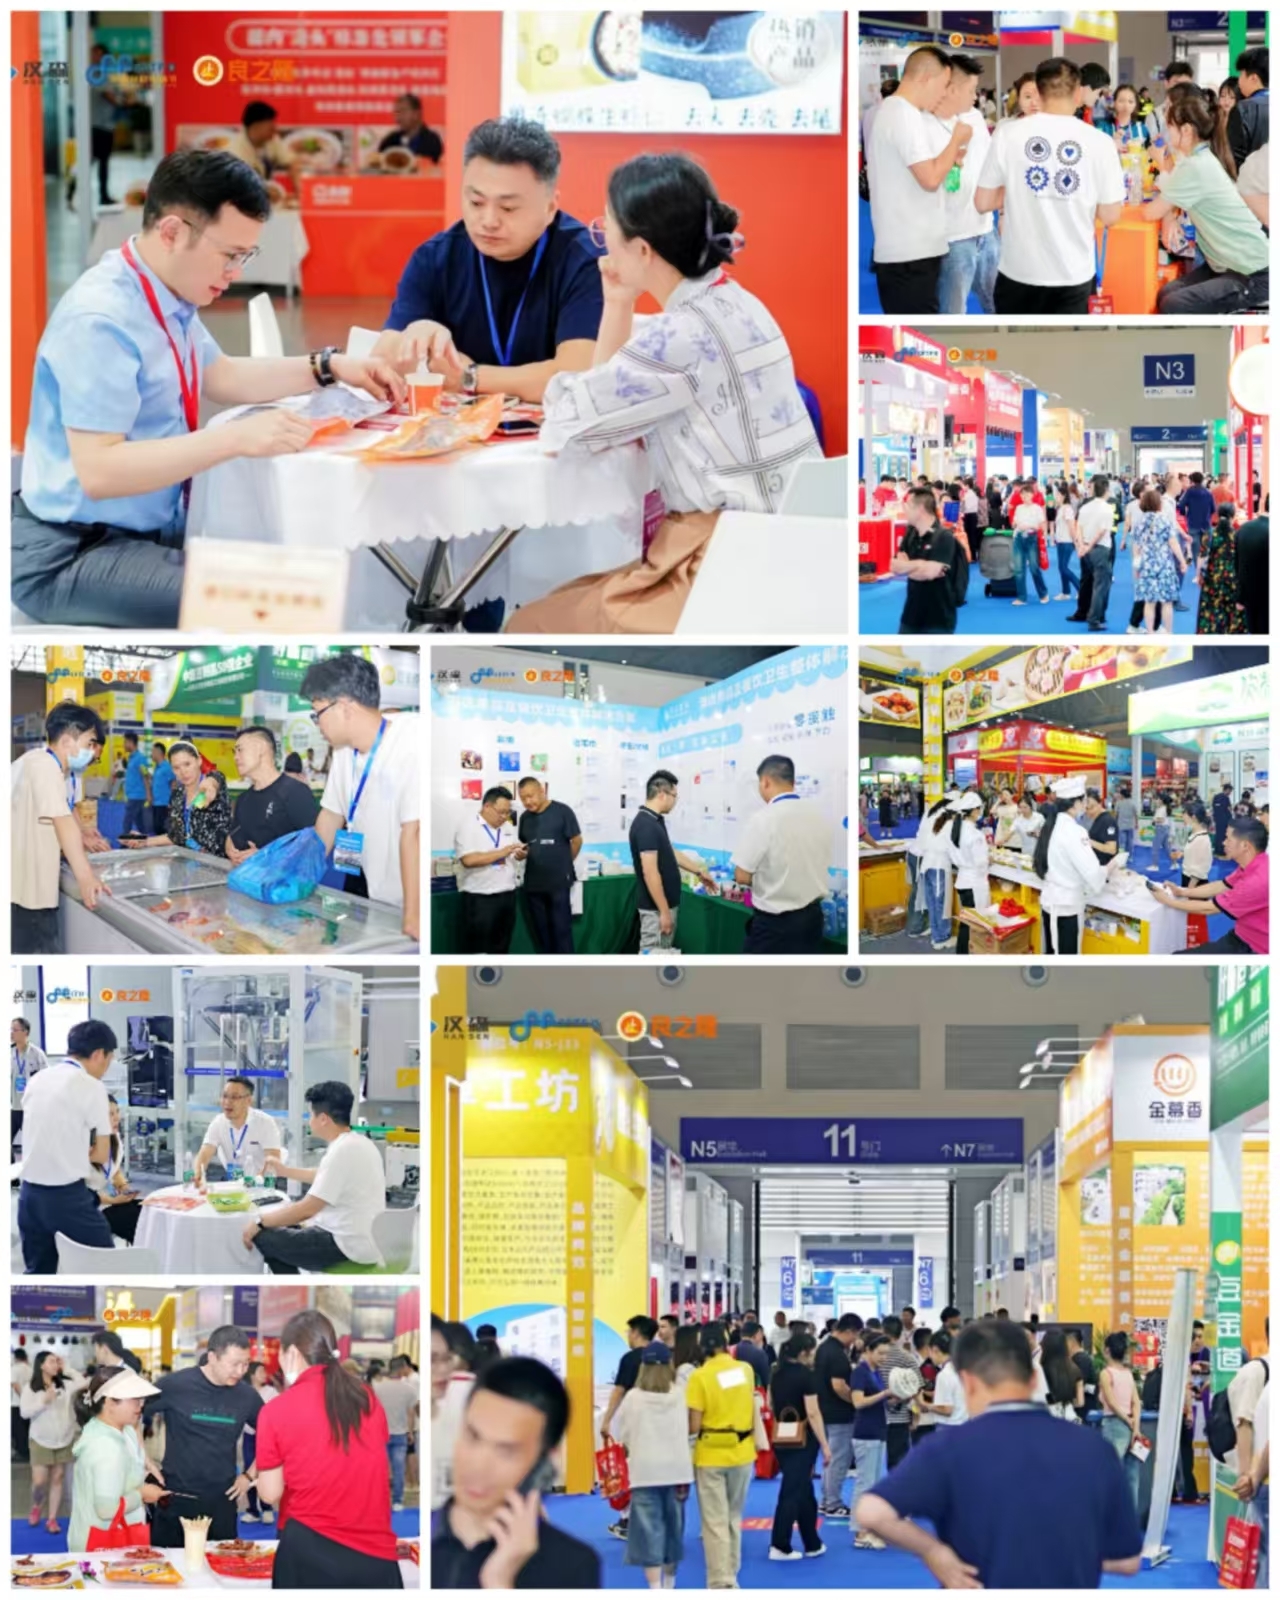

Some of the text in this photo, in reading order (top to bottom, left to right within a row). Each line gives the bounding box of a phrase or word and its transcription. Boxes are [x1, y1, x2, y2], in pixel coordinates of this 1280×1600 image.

[1155, 361, 1185, 380] N3
[1161, 428, 1170, 440] 2
[824, 1124, 856, 1157] 11
[691, 1140, 717, 1157] N5
[954, 1144, 976, 1158] N7
[852, 1252, 863, 1263] 11
[783, 1271, 794, 1285] 6
[919, 1271, 929, 1286] 6
